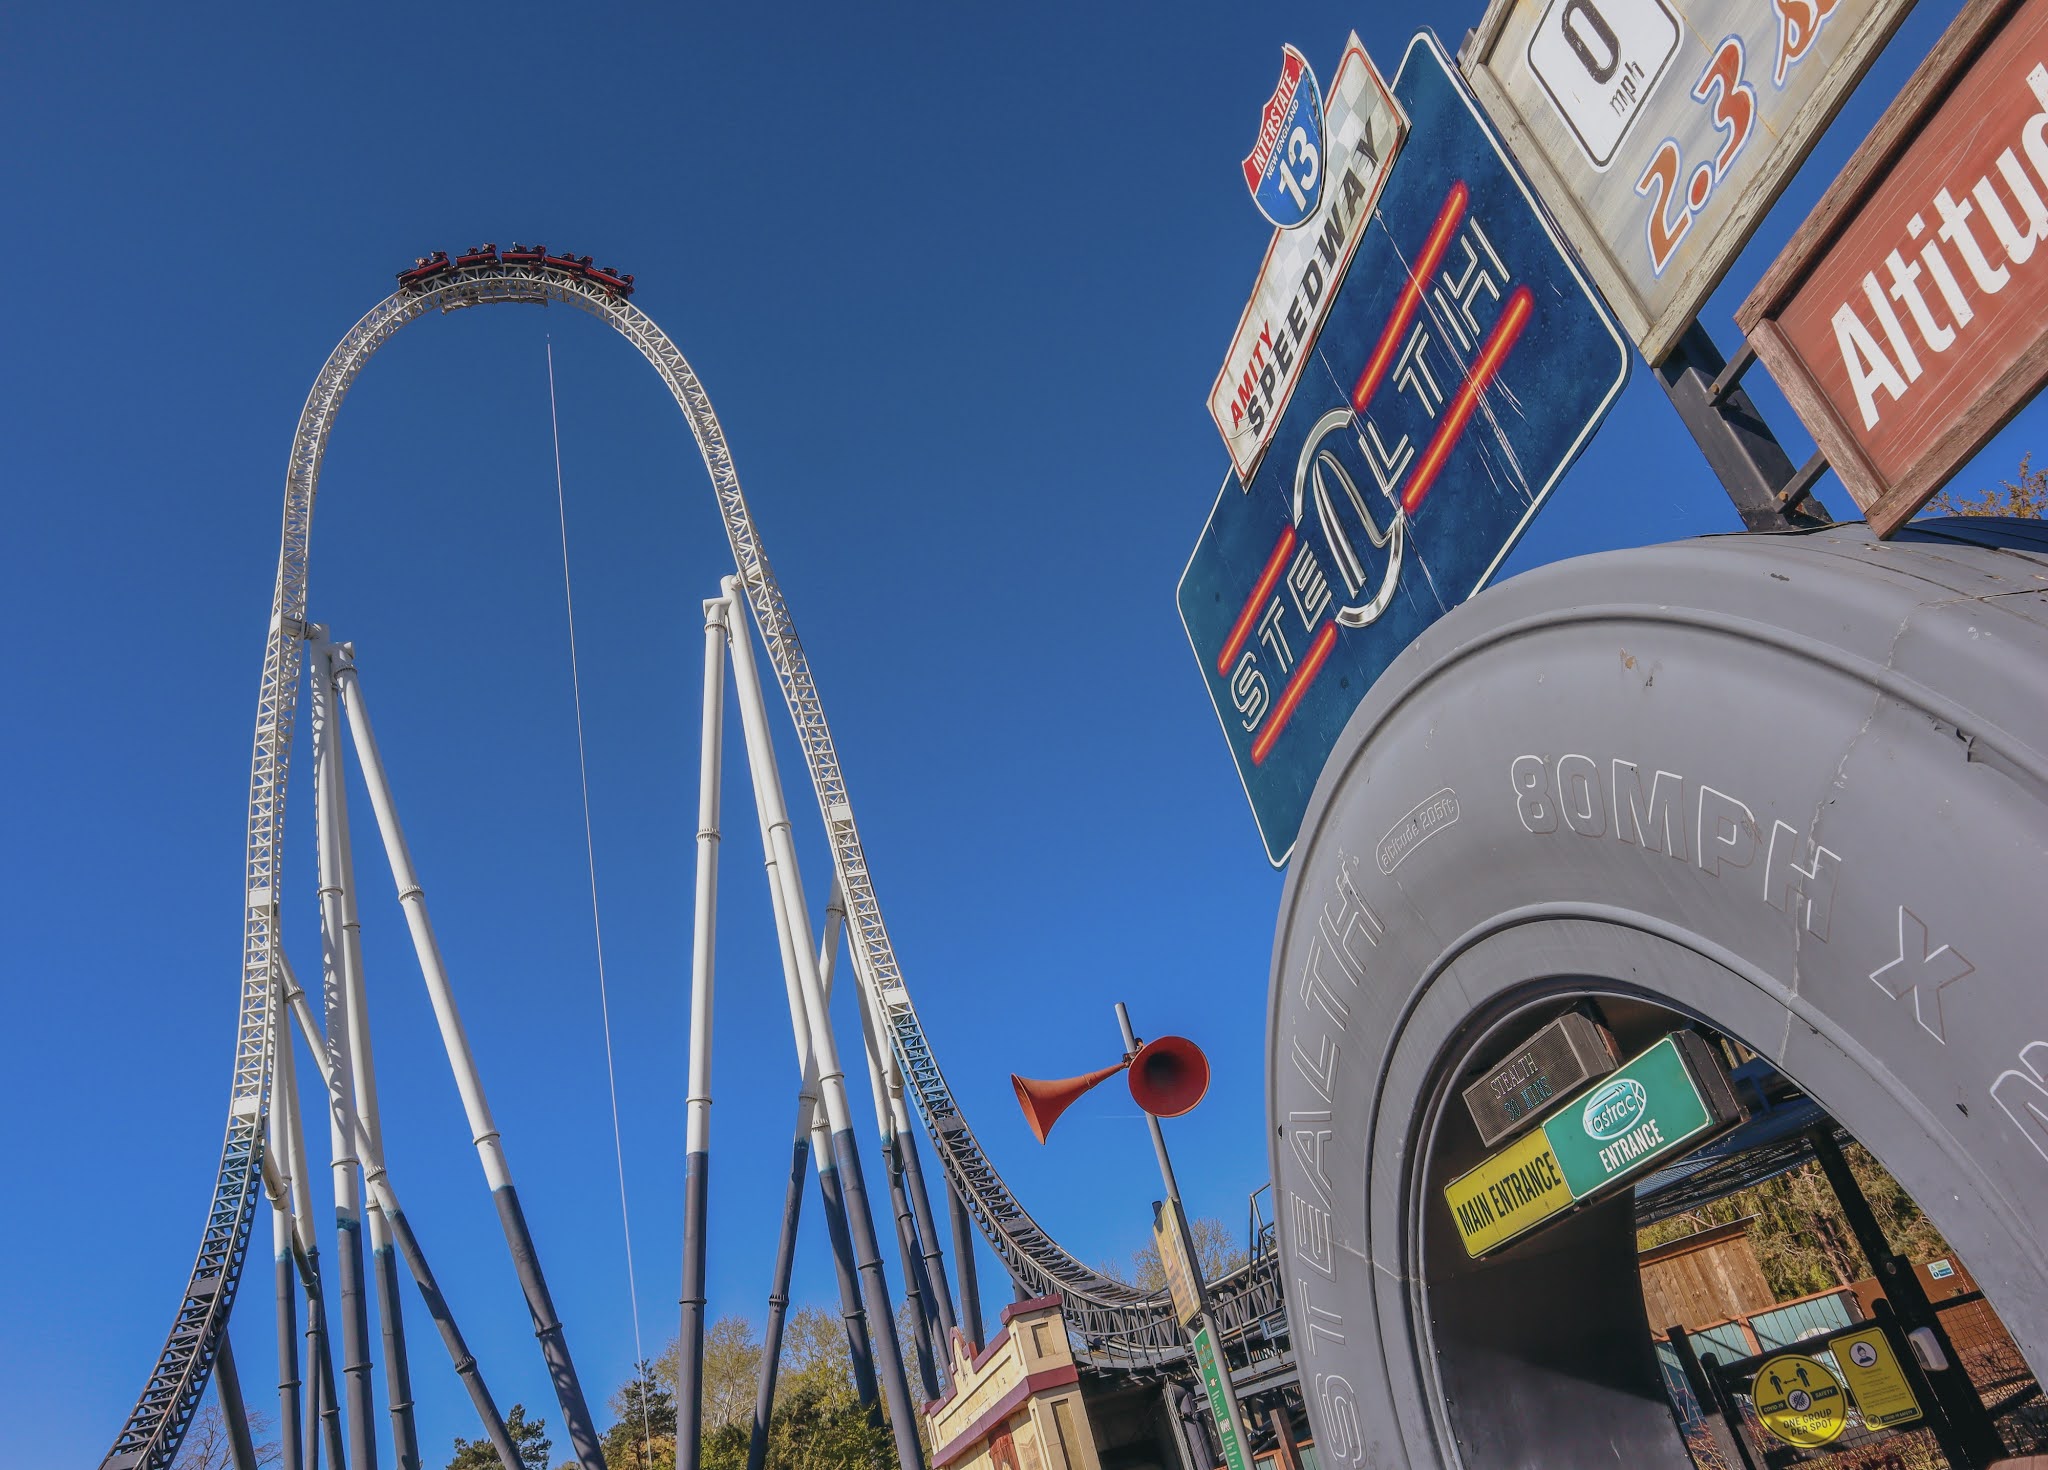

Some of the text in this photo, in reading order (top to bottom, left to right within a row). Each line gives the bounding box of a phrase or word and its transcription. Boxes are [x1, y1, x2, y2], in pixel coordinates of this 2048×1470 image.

[1252, 69, 1297, 175] INTERSTATE
[1609, 61, 1645, 117] mph
[1266, 98, 1300, 180] NEW ENGLAND
[1278, 126, 1319, 212] 13
[1634, 33, 1757, 279] 2.3
[1247, 116, 1380, 438] SPEEDWAY
[1230, 320, 1273, 431] AMITY
[1231, 216, 1511, 733] STEALTH
[1381, 823, 1420, 867] altitude
[1289, 861, 1386, 1469] STEALTH
[1511, 754, 1842, 943] 80MPH
[1490, 1052, 1539, 1099] STEALTH
[1520, 1075, 1554, 1110] MINS
[1599, 1118, 1664, 1173] ENTRANCE
[1456, 1151, 1562, 1237] MAIN ENTRANCE
[1783, 1408, 1832, 1429] ONE GROUP
[1791, 1418, 1833, 1437] PER SPOT
